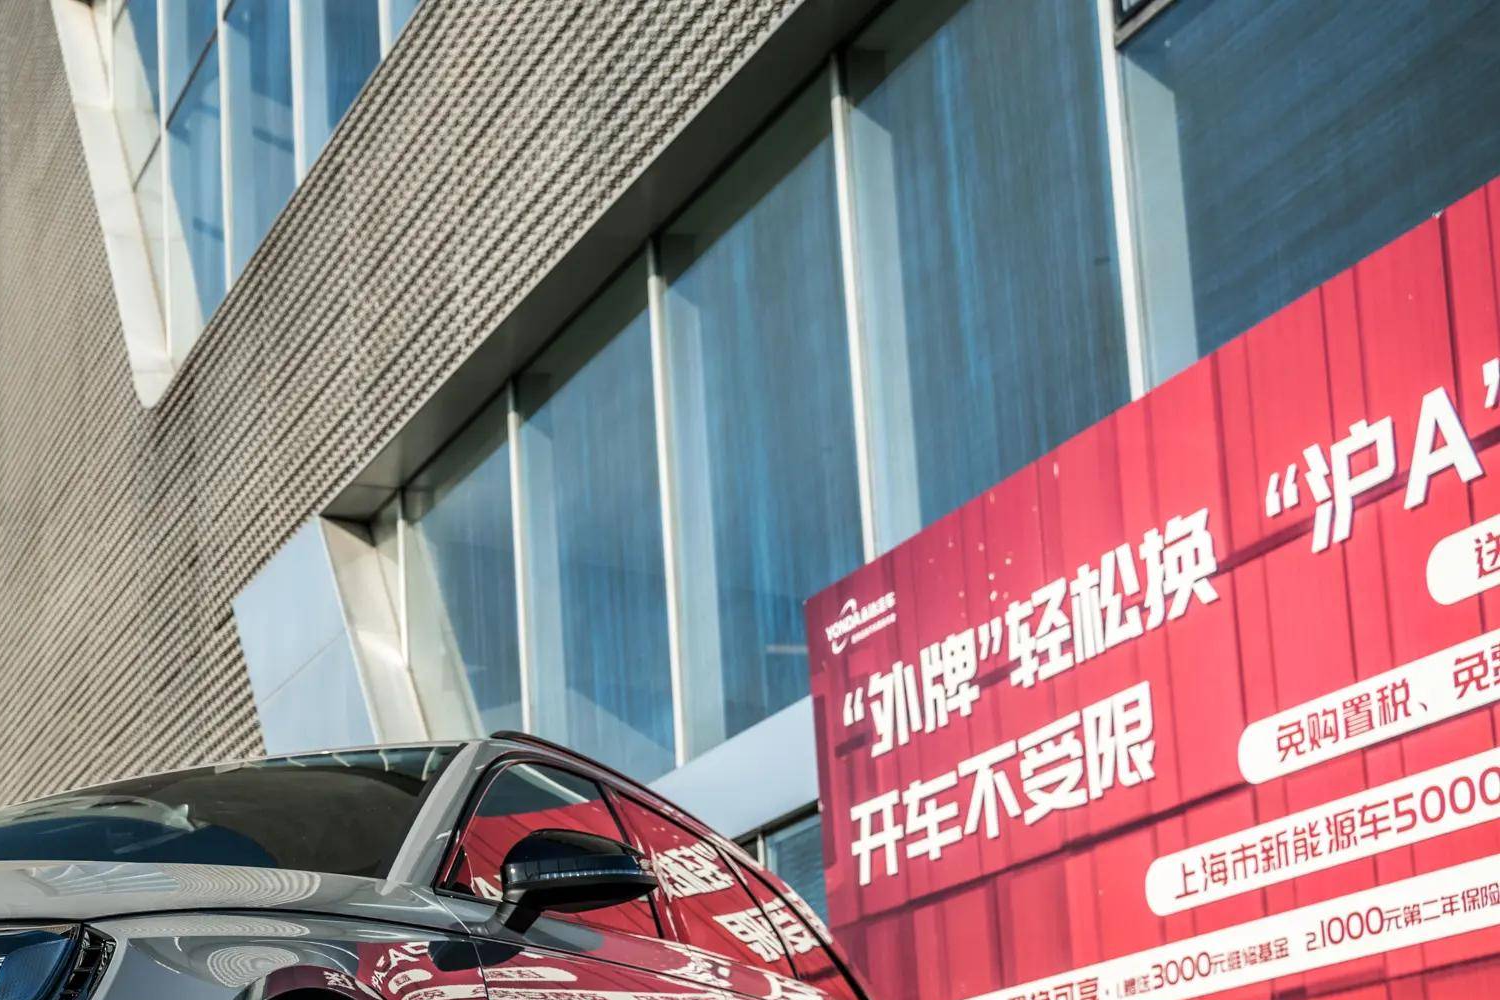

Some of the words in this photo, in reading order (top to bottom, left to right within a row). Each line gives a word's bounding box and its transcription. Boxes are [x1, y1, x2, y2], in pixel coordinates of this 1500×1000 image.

[851, 681, 1156, 885] 开车不受限
[1277, 643, 1500, 762] 免购置税、免
